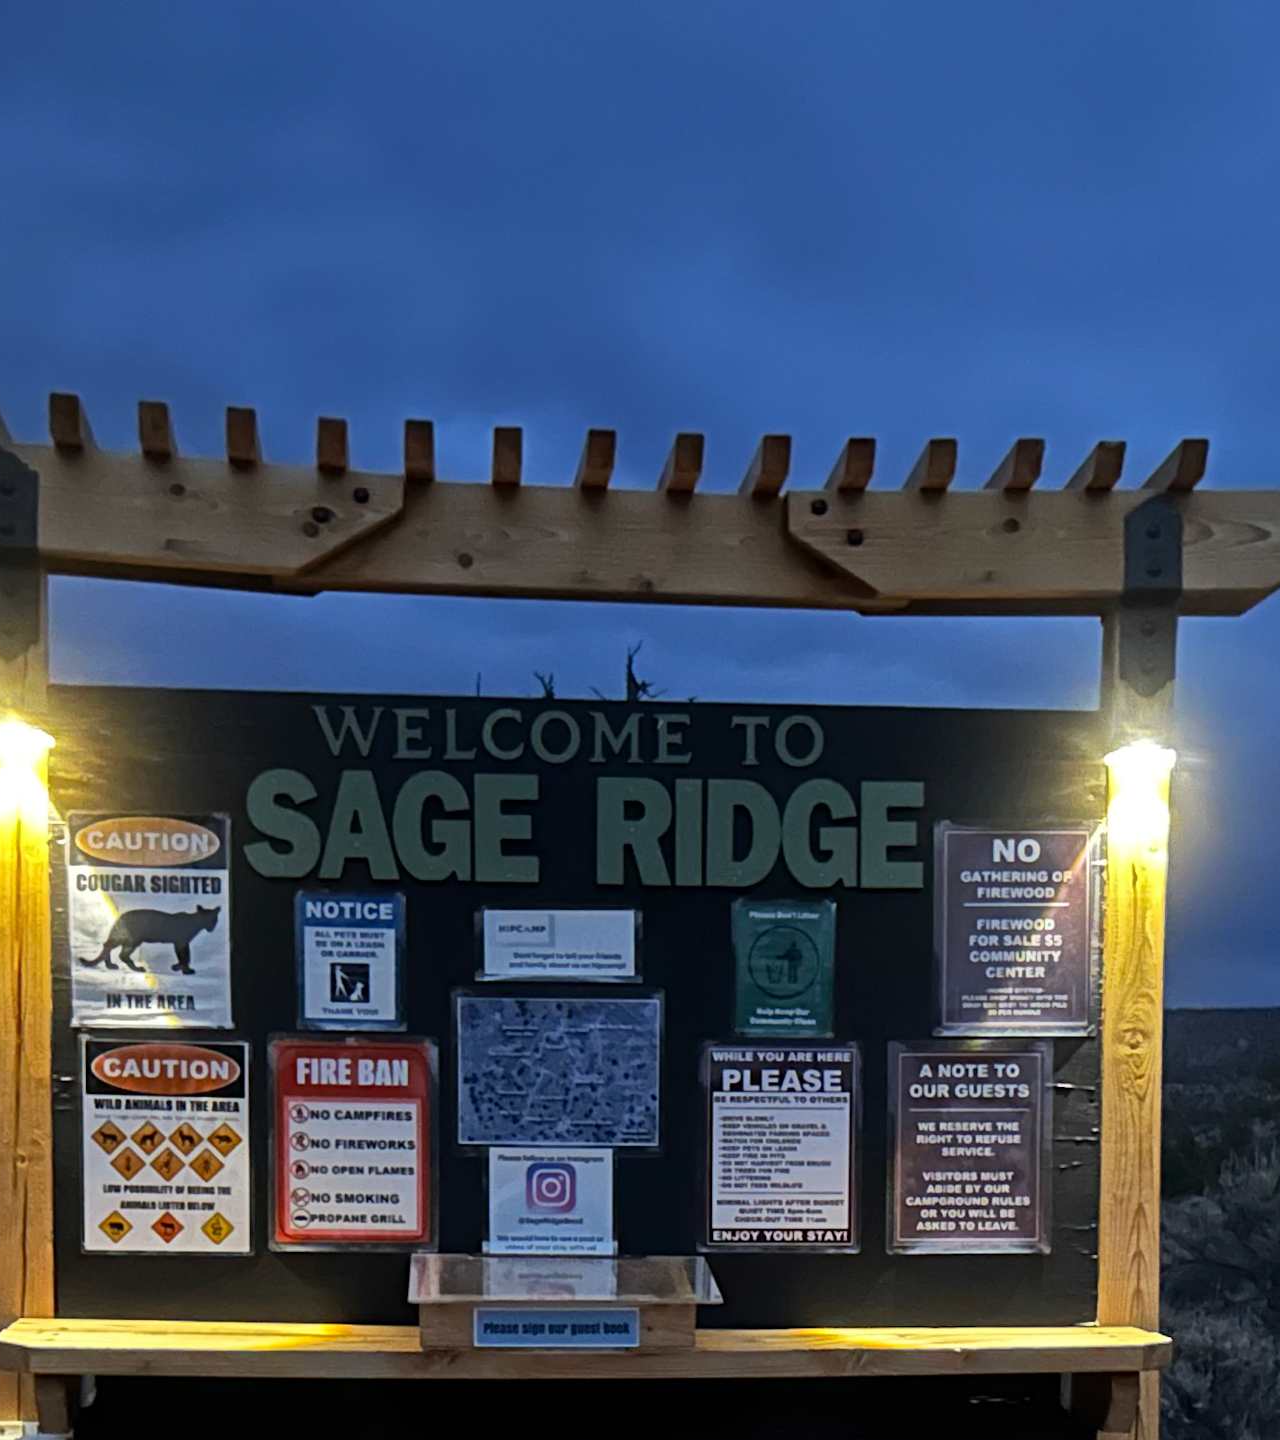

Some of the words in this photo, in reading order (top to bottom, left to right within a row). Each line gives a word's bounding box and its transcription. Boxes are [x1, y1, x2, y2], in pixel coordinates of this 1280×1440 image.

[313, 706, 693, 764] WELCOME
[731, 714, 824, 766] TO
[243, 769, 539, 882] SAGE
[597, 777, 924, 888] RIDGE
[87, 831, 209, 853] CAUTION
[992, 839, 1041, 863] NO
[960, 871, 1048, 883] GATHERING
[1052, 871, 1072, 883] OF
[76, 874, 146, 892] COUGAR
[151, 875, 222, 894] SIGHTED
[977, 887, 1055, 898] FIREWOOD
[305, 901, 393, 920] NOTICE
[977, 918, 1055, 930] FIREWOOD
[969, 934, 999, 946] FOR
[1003, 934, 1041, 947] SALE
[1045, 934, 1063, 947] $5
[969, 950, 1062, 962] COMMUNITY
[986, 966, 1045, 978] CENTER
[106, 994, 121, 1009] IN
[127, 994, 152, 1009] THE
[157, 994, 196, 1010] AREA
[713, 1052, 753, 1062] WHILE
[757, 1052, 784, 1062] YOU
[787, 1052, 813, 1062] ARE
[817, 1052, 851, 1062] HERE
[103, 1058, 229, 1080] CAUTION
[296, 1058, 352, 1086] FIRE
[358, 1059, 409, 1087] BAN
[920, 1064, 933, 1078] A
[938, 1064, 988, 1078] NOTE
[994, 1064, 1020, 1078] TO
[722, 1069, 842, 1091] PLEASE
[909, 1084, 949, 1098] OUR
[954, 1084, 1030, 1099] GUESTS
[94, 1098, 122, 1110] WILD
[125, 1099, 173, 1111] ANIMALS
[176, 1100, 187, 1111] IN
[190, 1101, 209, 1112] THE
[212, 1101, 240, 1113] AREA
[310, 1110, 330, 1120] NO
[334, 1110, 413, 1121] CAMPFIRES
[917, 1122, 936, 1131] WE
[939, 1122, 992, 1131] RESERVE
[996, 1122, 1019, 1131] THE
[310, 1139, 330, 1149] NO
[335, 1139, 416, 1150] FIREWORKS
[916, 1135, 953, 1144] RIGHT
[956, 1135, 972, 1144] TO
[975, 1135, 1021, 1144] REFUSE
[941, 1147, 995, 1157] SERVICE.
[310, 1166, 328, 1174] NO
[332, 1166, 364, 1175] OPEN
[368, 1166, 415, 1176] FLAMES
[922, 1171, 978, 1181] VISITORS
[980, 1171, 1014, 1181] MUST
[926, 1184, 961, 1193] ABIDE
[965, 1184, 981, 1193] BY
[984, 1184, 1010, 1193] OUR
[311, 1193, 330, 1203] NO
[335, 1193, 400, 1204] SMOKING
[905, 1196, 989, 1206] CAMPGROUND
[991, 1196, 1030, 1206] RULES
[310, 1214, 367, 1224] PROPANE
[370, 1214, 406, 1224] GRILL
[920, 1209, 937, 1218] OR
[940, 1209, 966, 1218] YOU
[968, 1209, 997, 1218] WILL
[999, 1209, 1016, 1218] BE
[916, 1222, 956, 1231] ASKED
[959, 1222, 975, 1231] TO
[978, 1222, 1019, 1231] LEAVE.
[713, 1230, 759, 1241] ENJOY
[763, 1231, 803, 1241] YOUR
[806, 1231, 848, 1241] STAY!
[483, 1322, 519, 1334] Please
[522, 1322, 545, 1336] sign
[548, 1323, 568, 1334] our
[571, 1323, 600, 1336] guest
[603, 1322, 630, 1334] book
